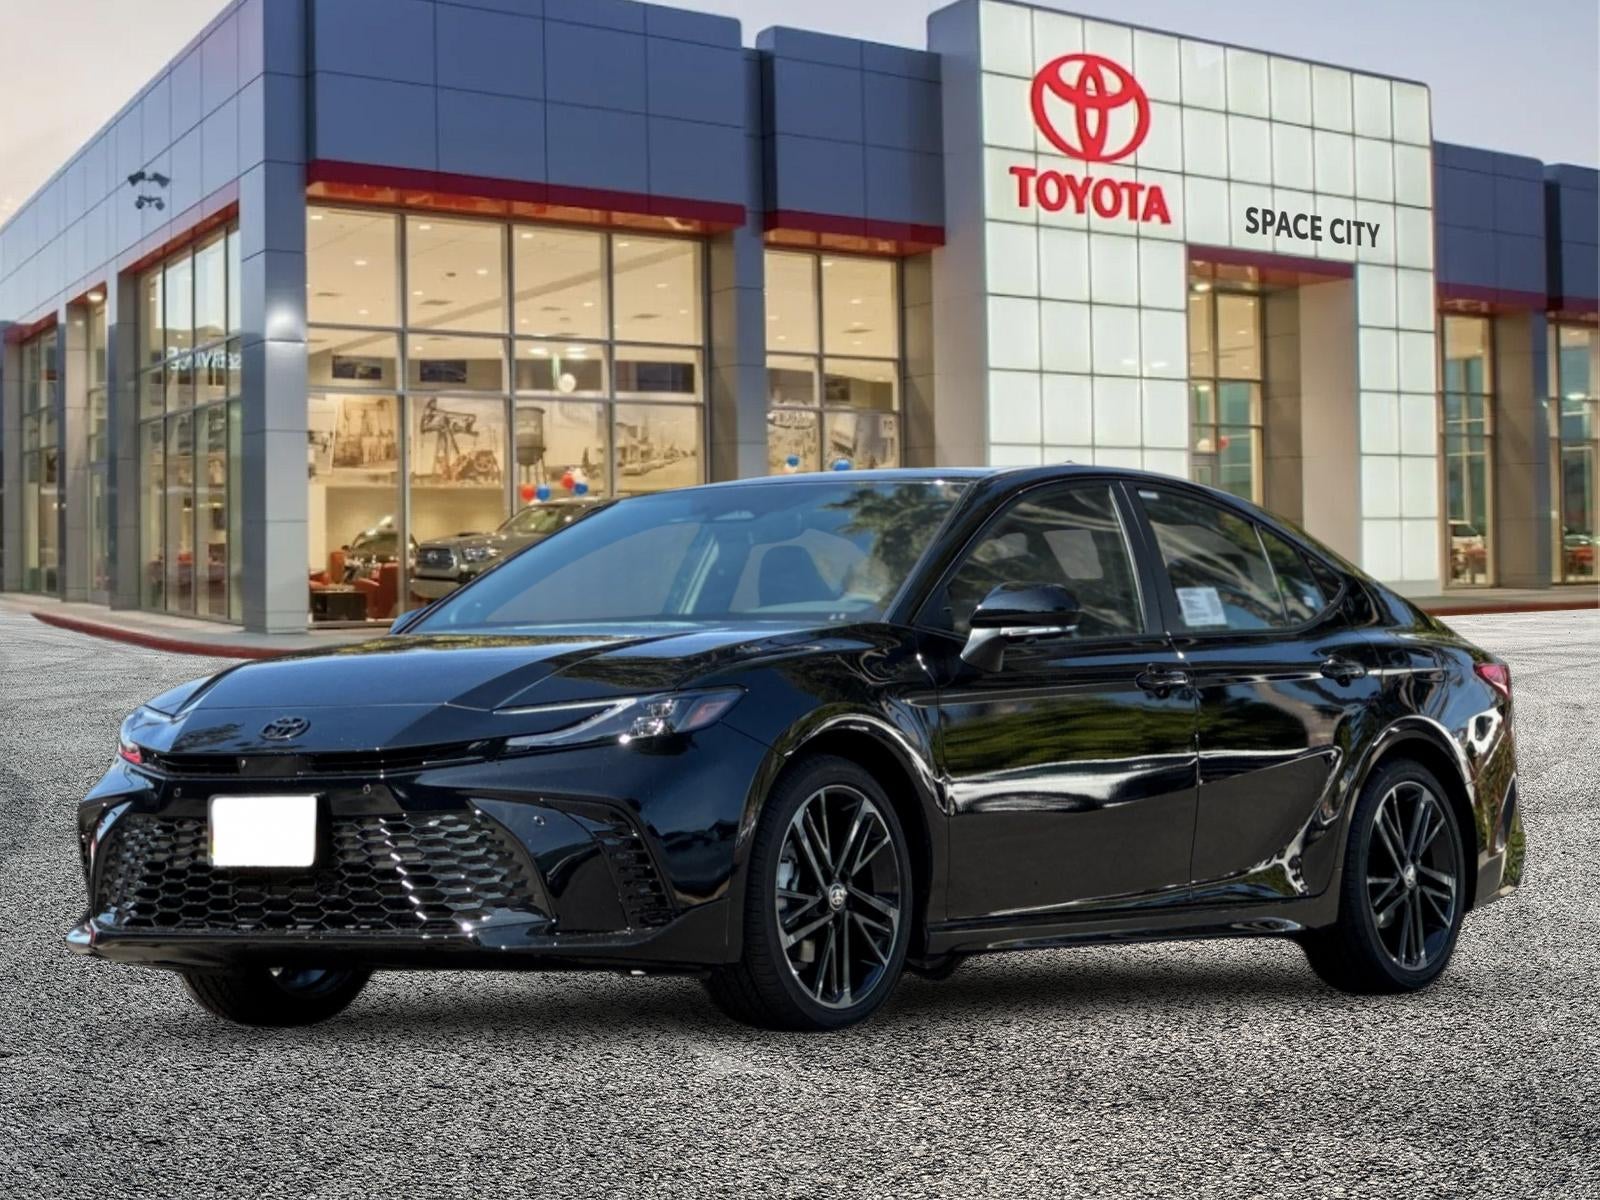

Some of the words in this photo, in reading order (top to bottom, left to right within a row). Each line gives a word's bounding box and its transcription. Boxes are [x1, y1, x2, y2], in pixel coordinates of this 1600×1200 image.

[1009, 166, 1171, 225] TOYOTA
[1245, 206, 1322, 241] SPACE
[1330, 218, 1381, 248] CITY
